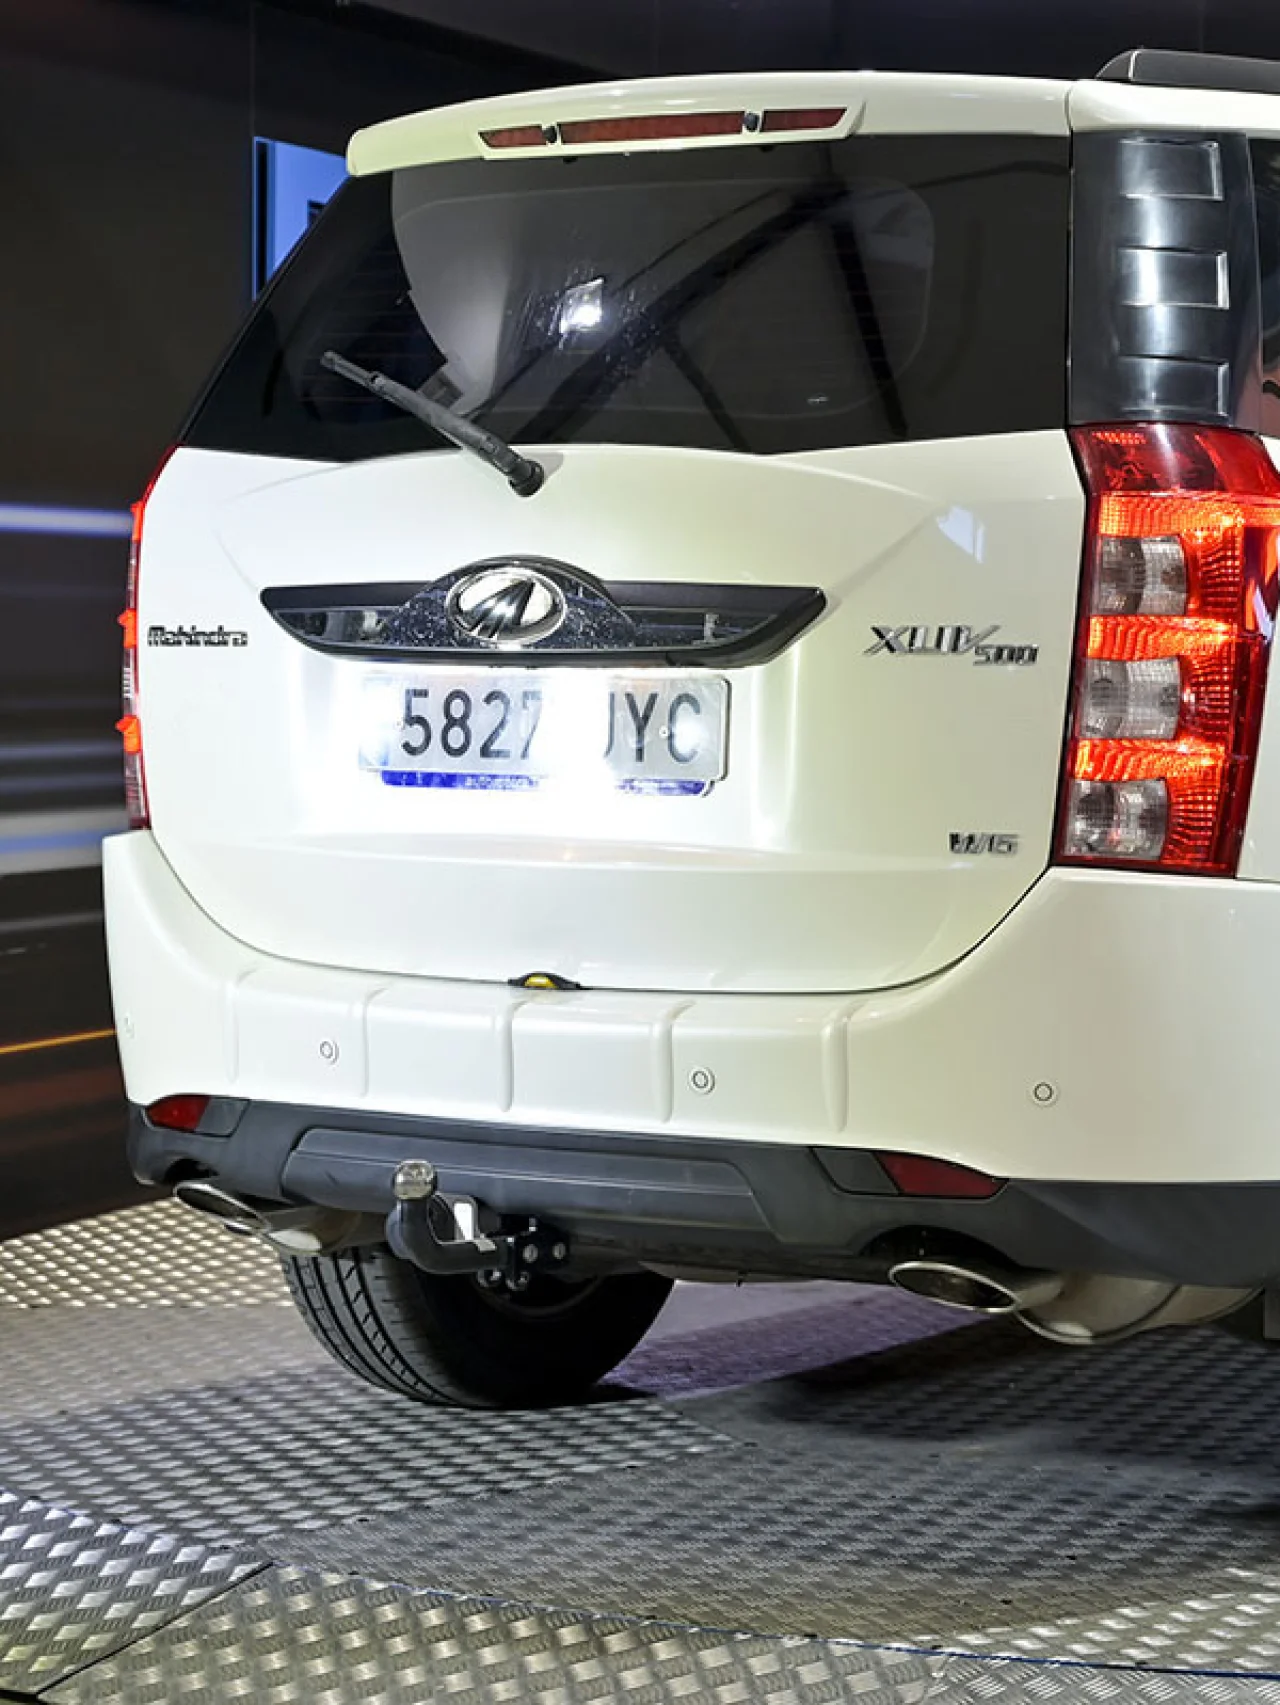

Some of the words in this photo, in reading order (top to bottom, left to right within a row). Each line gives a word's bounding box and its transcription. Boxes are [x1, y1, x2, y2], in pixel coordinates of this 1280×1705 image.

[148, 625, 248, 647] Mahindra
[399, 687, 544, 760] 5827
[948, 832, 1020, 855] W6
